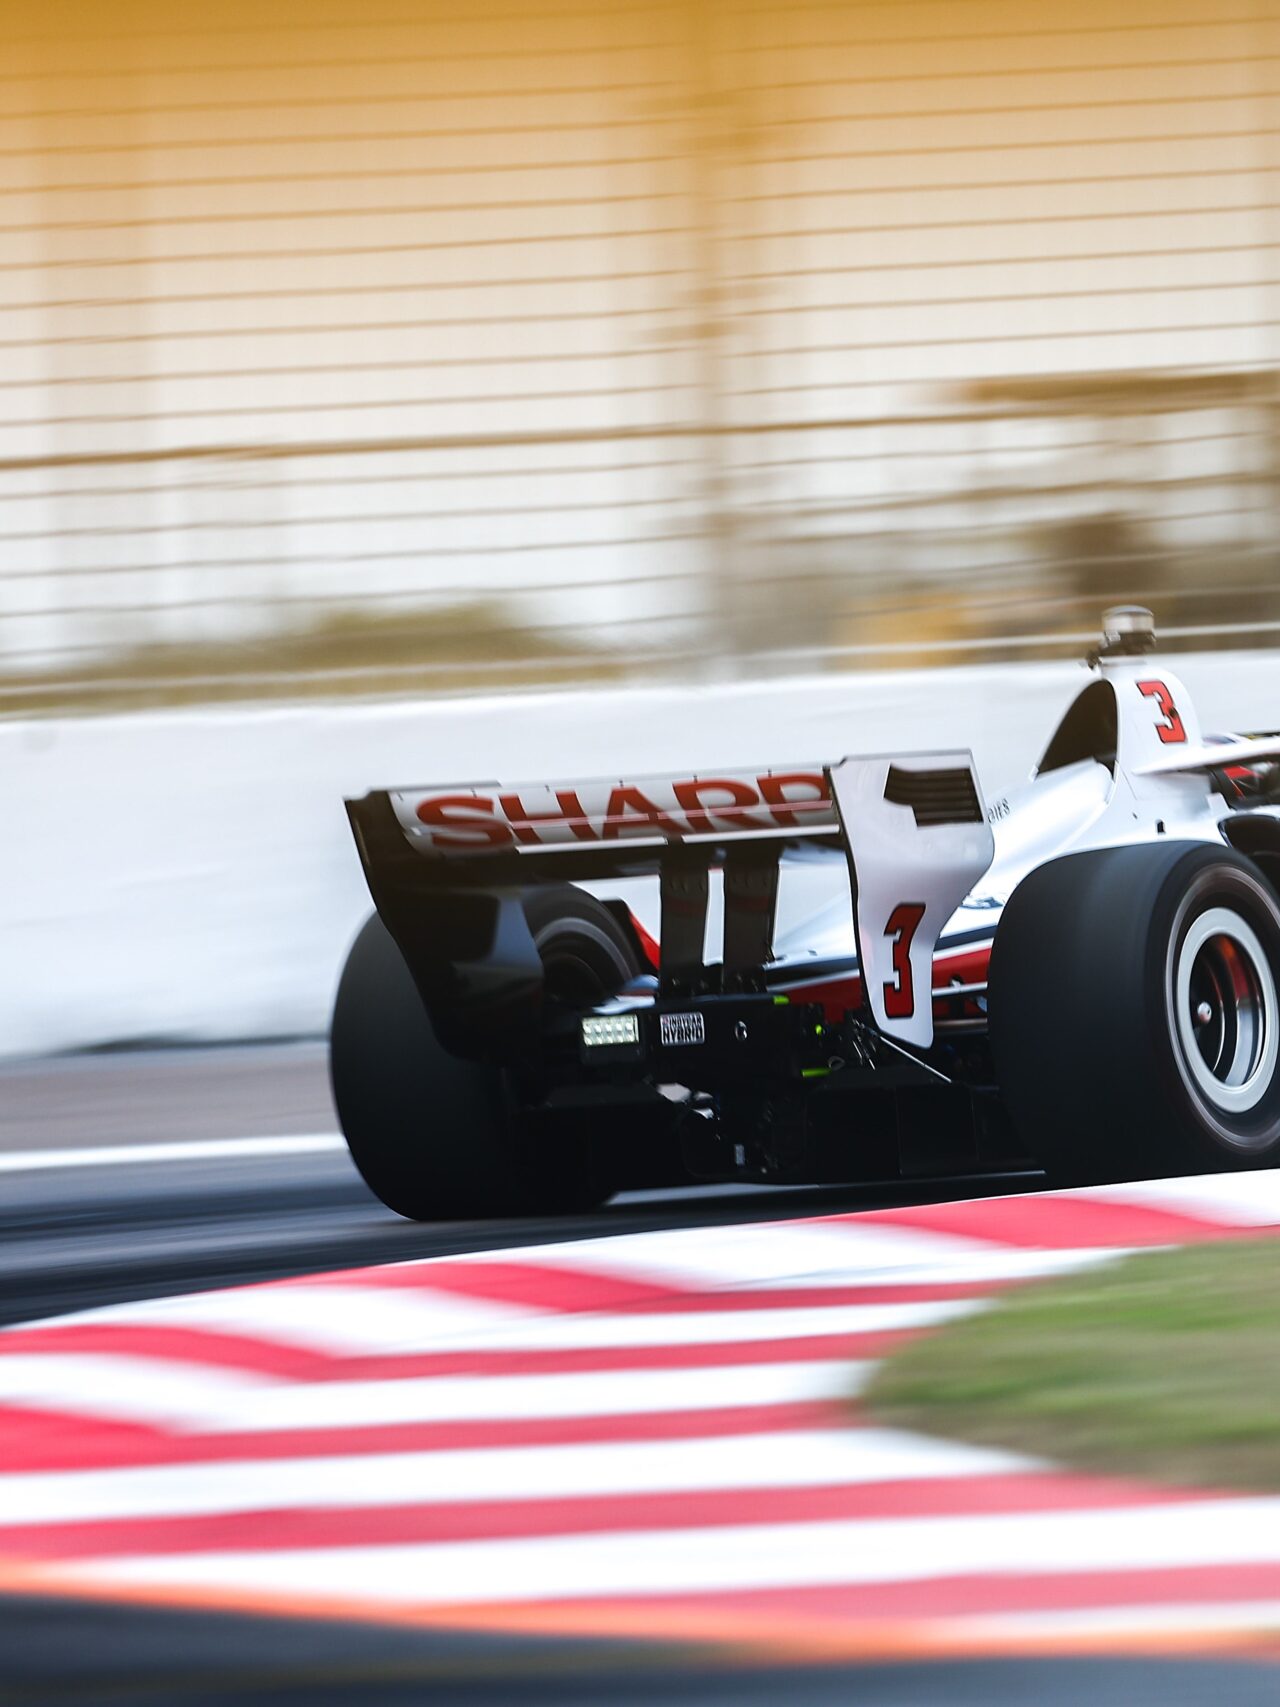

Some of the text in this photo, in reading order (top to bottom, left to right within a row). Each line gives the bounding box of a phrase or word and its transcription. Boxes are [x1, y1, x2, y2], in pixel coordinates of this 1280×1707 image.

[1136, 680, 1187, 744] 3
[416, 773, 830, 850] SHARP
[883, 902, 926, 1019] 3
